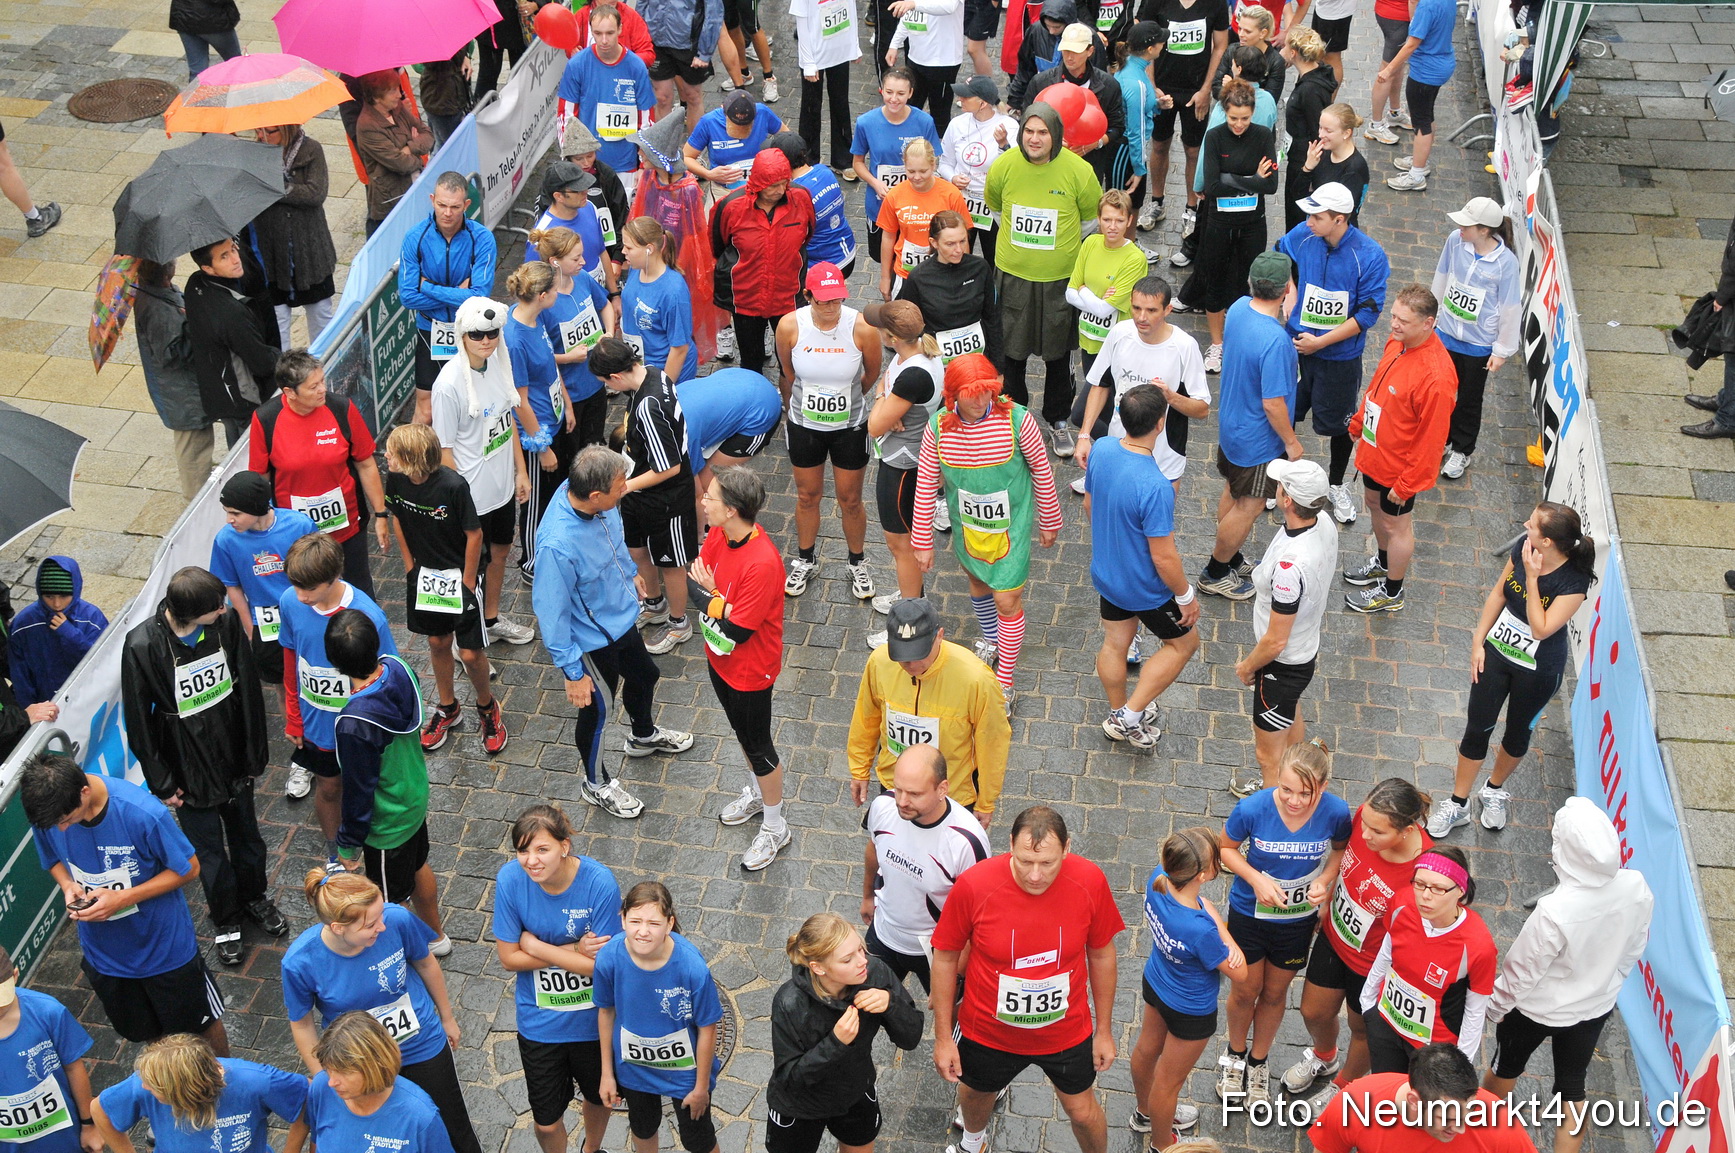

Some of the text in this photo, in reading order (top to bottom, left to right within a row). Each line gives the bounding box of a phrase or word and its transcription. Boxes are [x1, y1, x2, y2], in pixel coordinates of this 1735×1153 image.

[825, 9, 848, 27] 5179
[1172, 29, 1203, 43] 5215
[606, 114, 630, 127] 104
[487, 173, 499, 192] Ihr
[964, 197, 991, 215] 016
[1015, 216, 1052, 235] 5074
[1307, 297, 1343, 316] 5032
[1448, 285, 1479, 313] 5205
[1308, 315, 1338, 324] Sebastian
[377, 334, 396, 367] Fun
[397, 320, 406, 340] &
[943, 334, 982, 358] 5058
[379, 333, 418, 393] sicheren
[807, 395, 847, 412] 5069
[964, 501, 1005, 519] 5104
[973, 518, 997, 529] Werner
[1509, 581, 1523, 593] no
[1493, 622, 1534, 653] 5027
[1498, 643, 1521, 659] Sandra
[179, 662, 225, 699] 5037
[301, 671, 344, 697] 5024
[192, 687, 222, 707] Michael
[311, 695, 330, 705] Timo
[889, 722, 934, 747] 5102
[1598, 709, 1622, 811] TUI
[886, 850, 924, 878] ERDINGER
[1272, 905, 1307, 915] Theresa
[1335, 884, 1363, 937] 5185
[33, 908, 57, 949] 6352
[368, 963, 378, 971] 12.
[1026, 956, 1046, 965] DEHN
[549, 993, 591, 1005] Elisabeth
[1005, 990, 1063, 1014] 5135
[1386, 980, 1427, 1023] 5091
[1014, 1014, 1050, 1024] Michael
[1388, 1005, 1414, 1031] Madlen
[628, 1041, 687, 1062] 5066
[0, 1092, 58, 1126] 5015
[16, 1121, 49, 1138] Tobias
[370, 1140, 402, 1150] STADTLAUF
